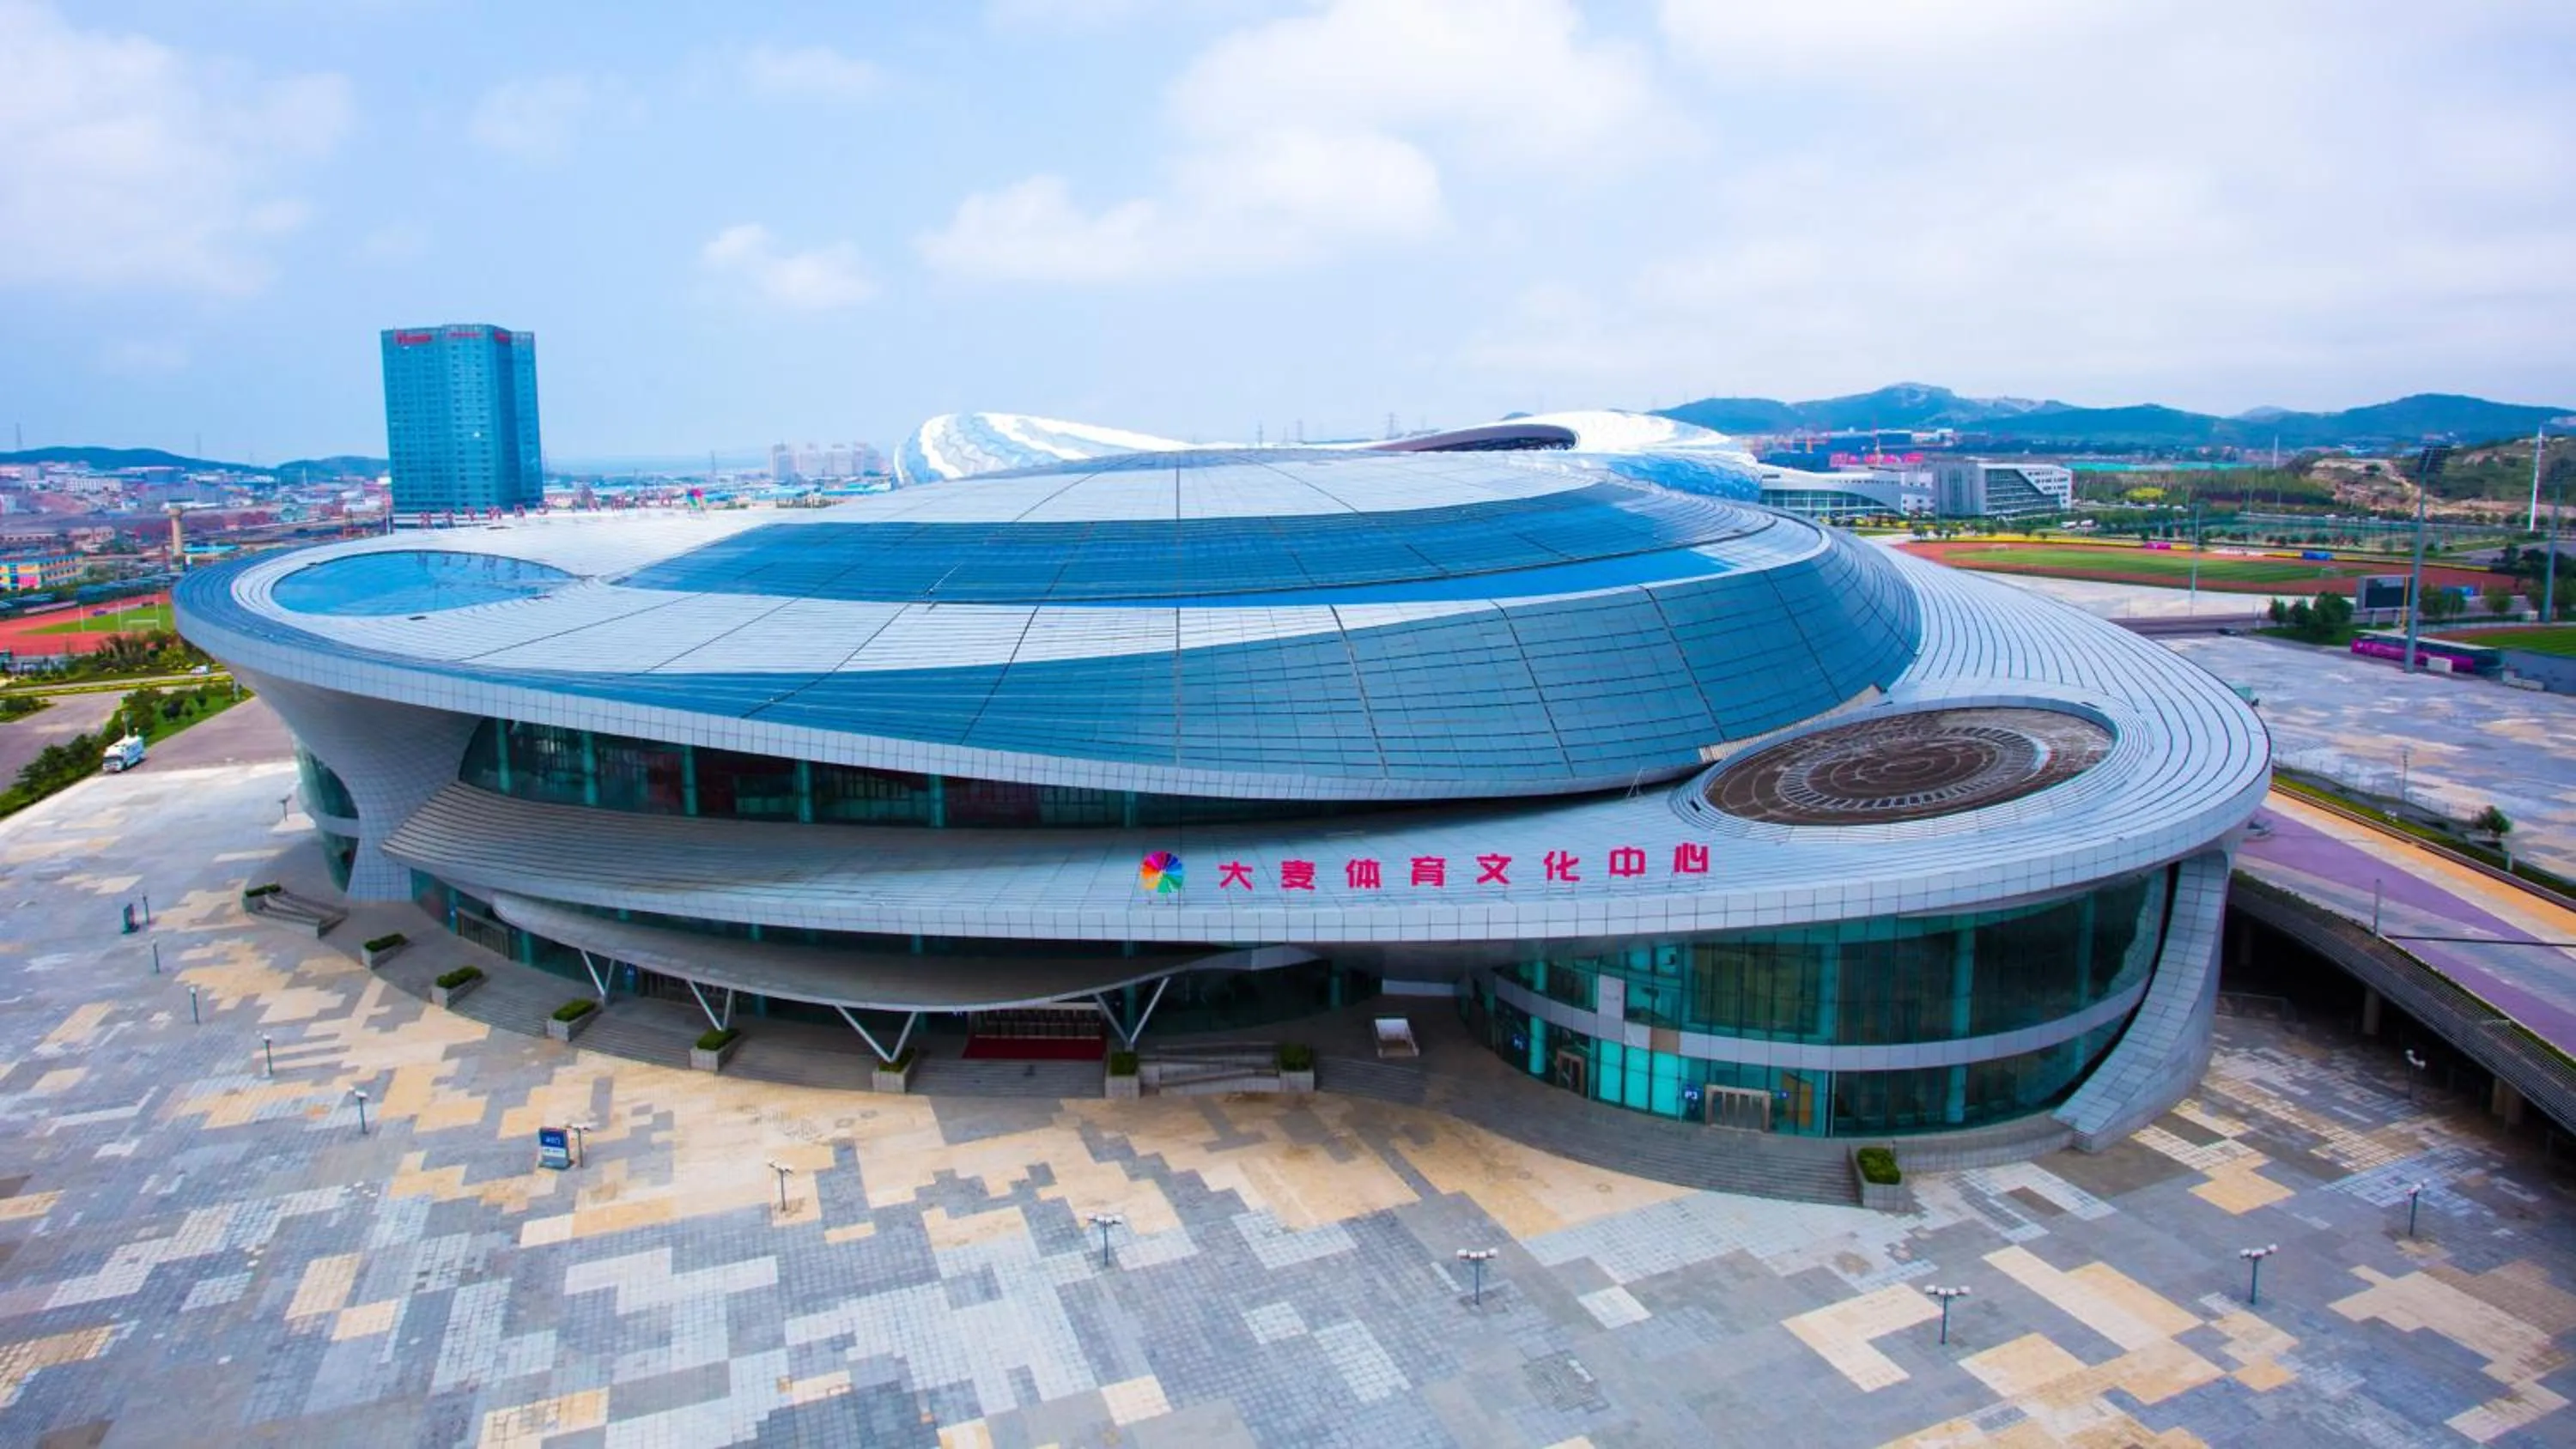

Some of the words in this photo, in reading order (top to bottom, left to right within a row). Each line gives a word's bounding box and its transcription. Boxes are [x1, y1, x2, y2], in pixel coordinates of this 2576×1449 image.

[1218, 841, 1710, 891] 大麦体育文化中心
